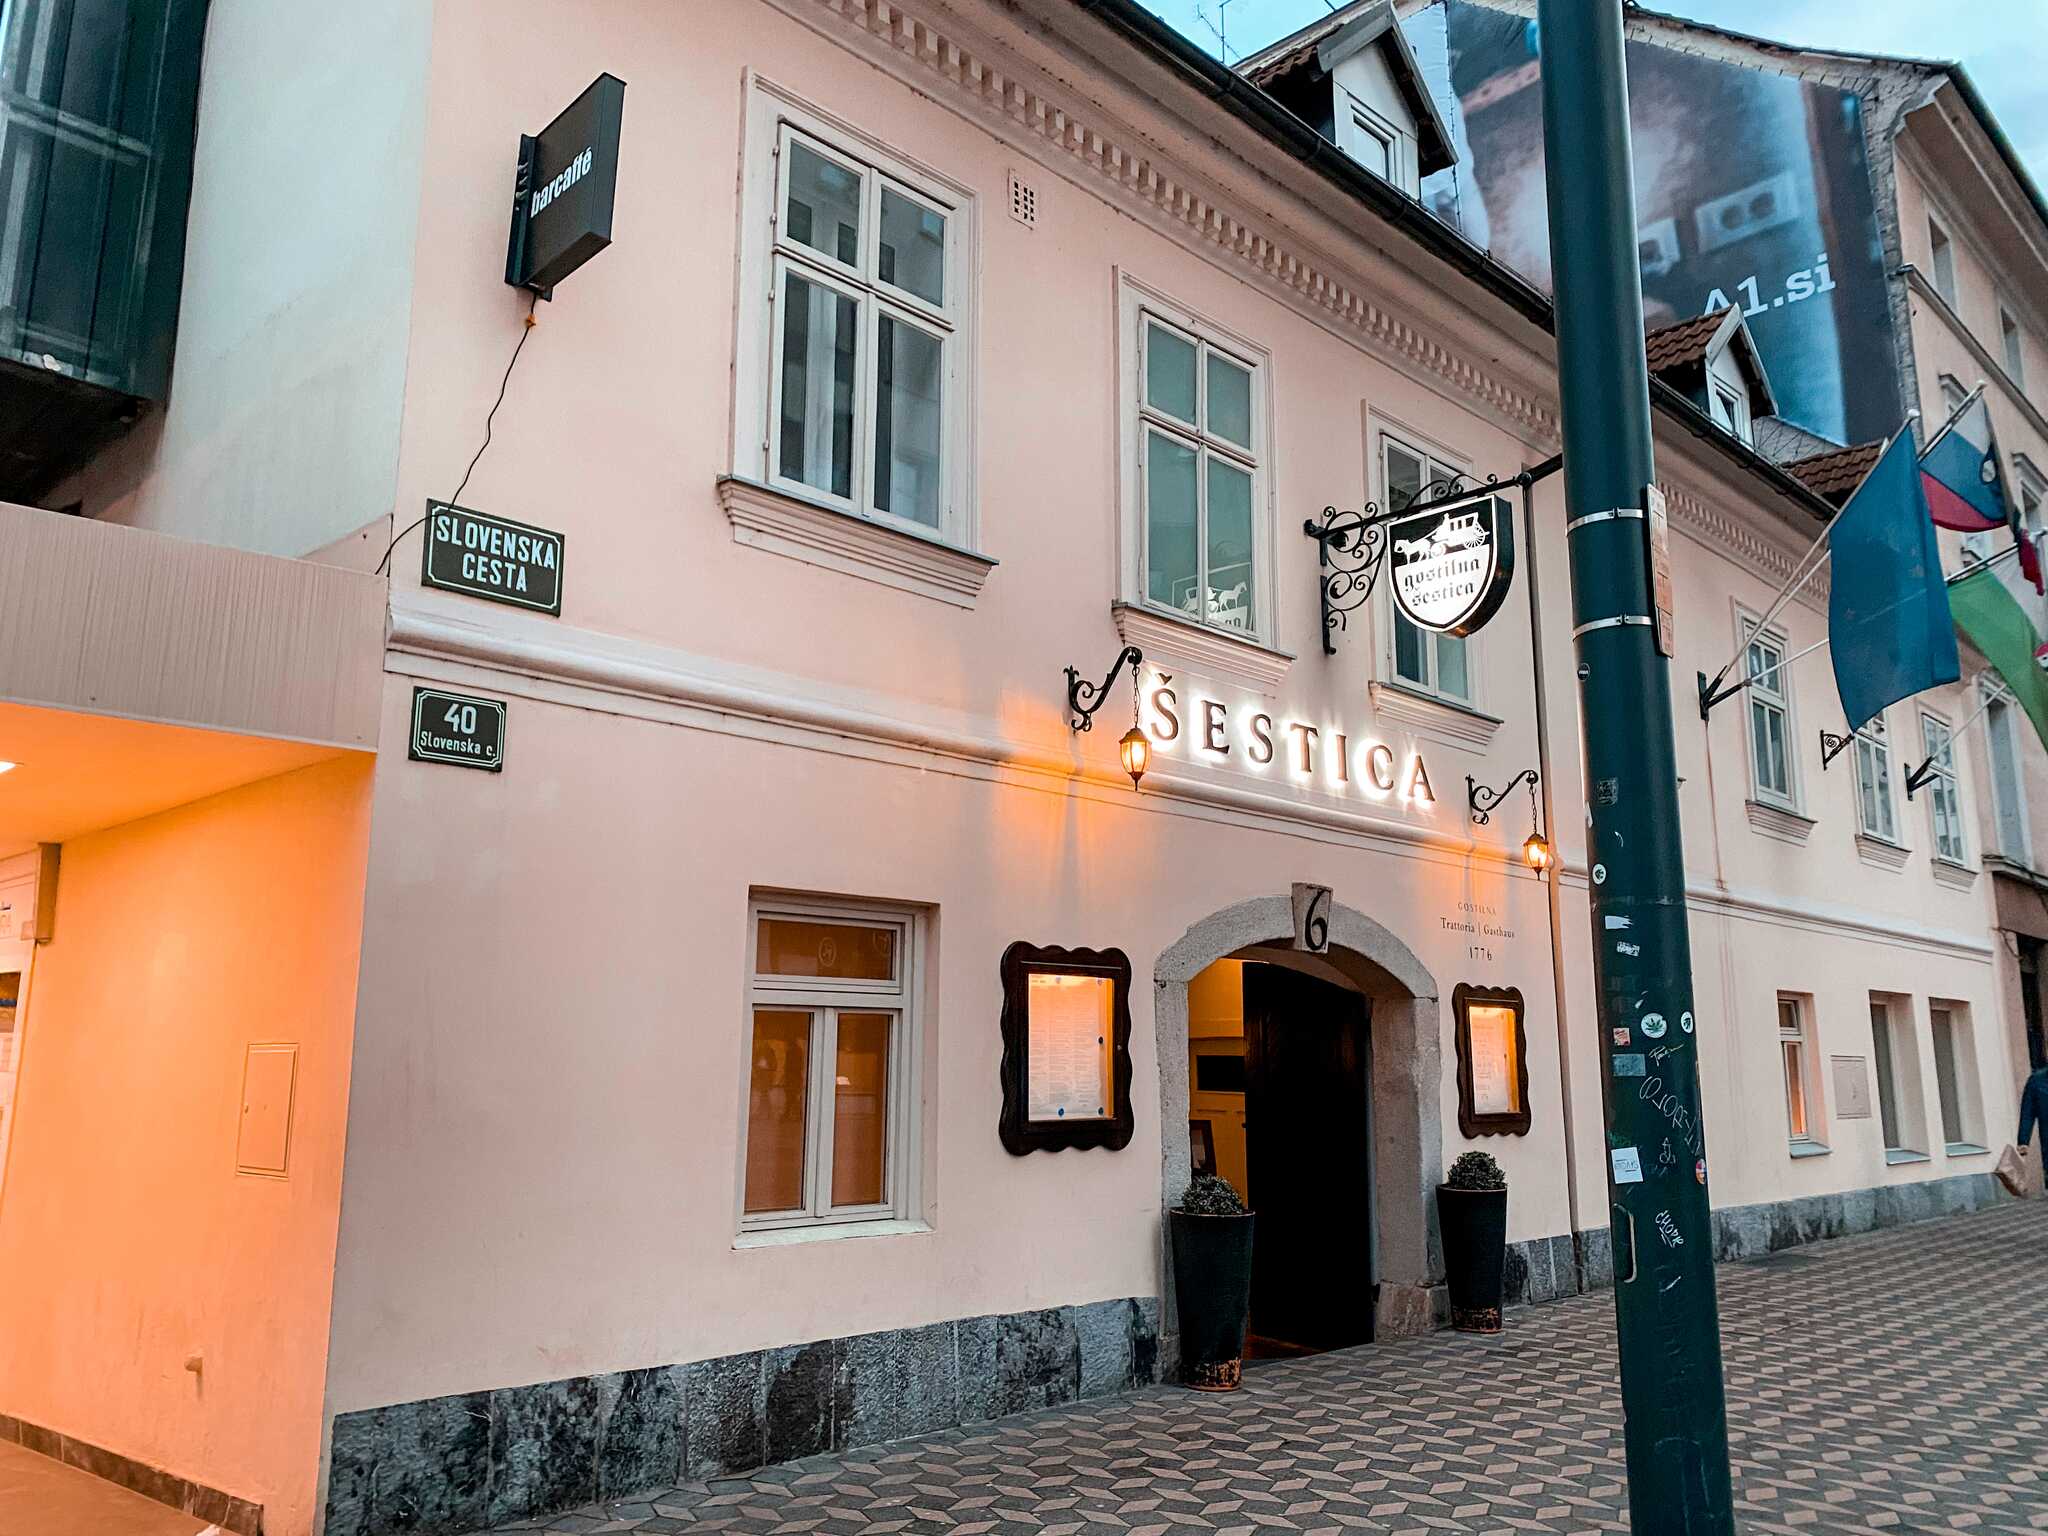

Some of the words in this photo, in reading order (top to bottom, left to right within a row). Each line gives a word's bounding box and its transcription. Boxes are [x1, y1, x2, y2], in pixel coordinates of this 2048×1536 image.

[530, 146, 593, 218] barcaffé
[1703, 252, 1836, 317] A1.si
[436, 515, 555, 570] SLOVENSKA
[462, 552, 527, 593] CESTA
[1404, 558, 1480, 592] gostilna
[443, 703, 477, 735] 40
[1150, 672, 1436, 802] ŠESTICA
[420, 730, 481, 755] Slovenska
[486, 745, 496, 757] c.
[1304, 889, 1331, 951] 6
[1440, 916, 1475, 933] Trattoria
[1483, 924, 1515, 938] Gasthaus
[1469, 946, 1493, 960] 1776
